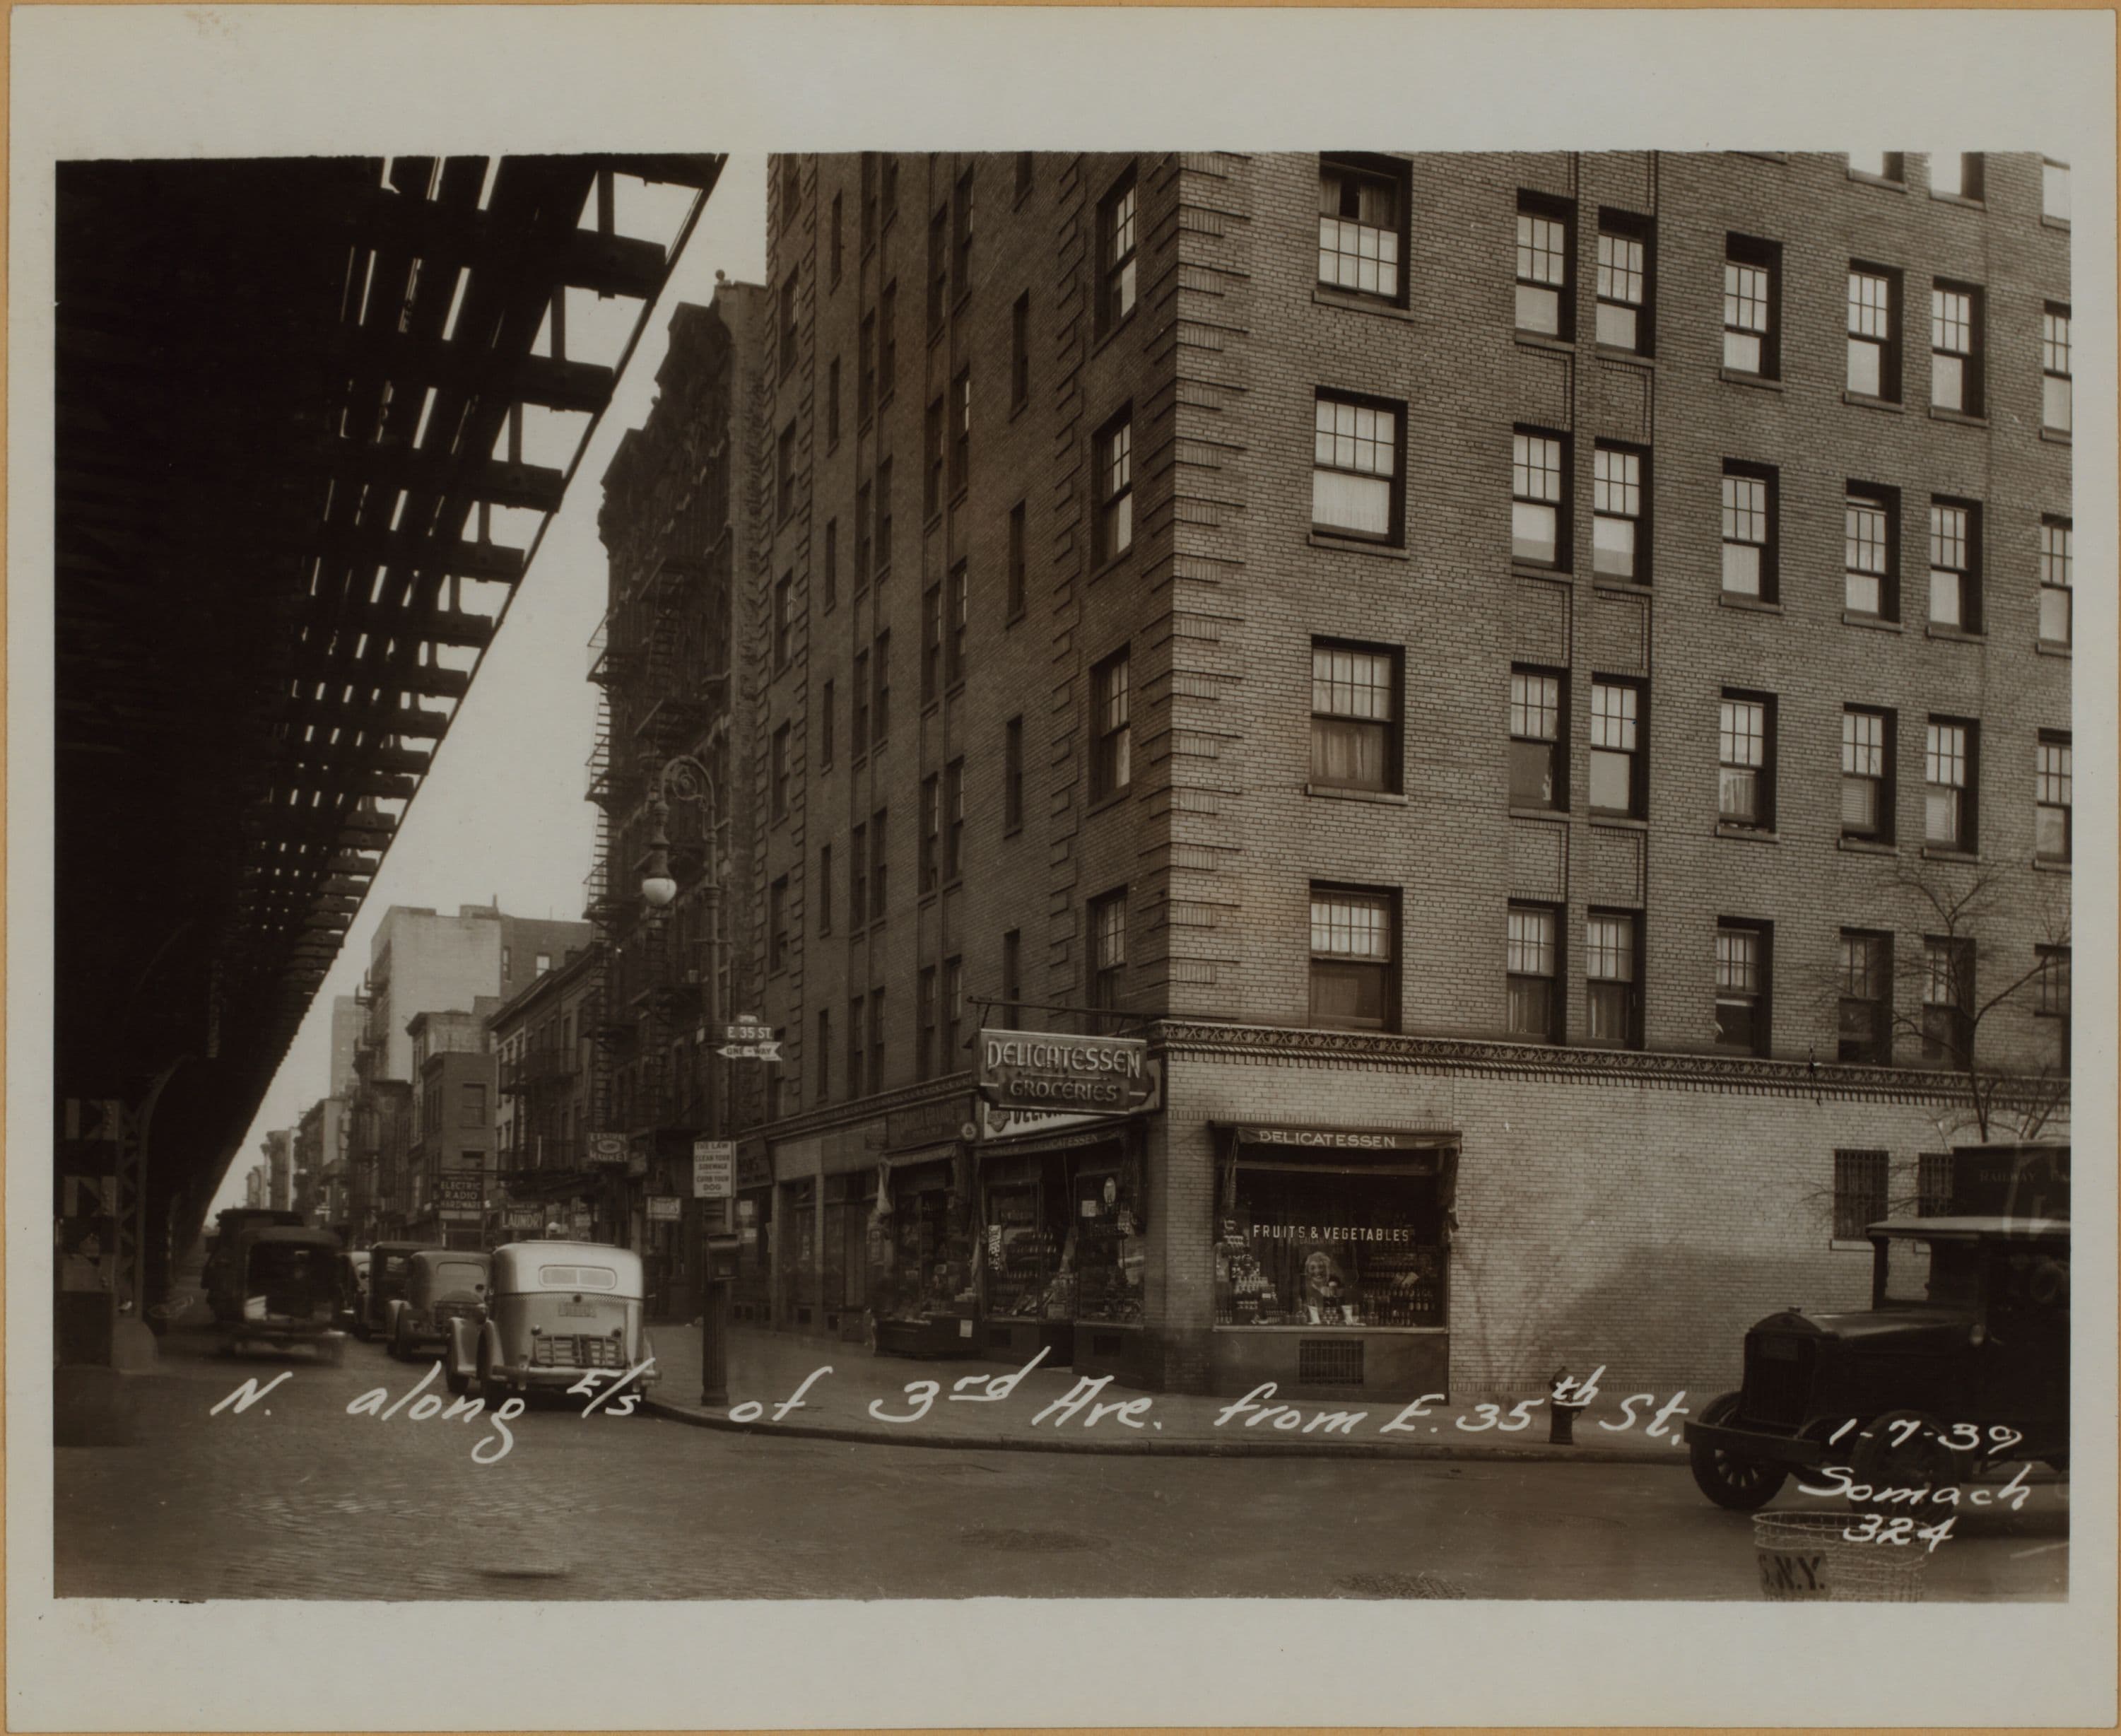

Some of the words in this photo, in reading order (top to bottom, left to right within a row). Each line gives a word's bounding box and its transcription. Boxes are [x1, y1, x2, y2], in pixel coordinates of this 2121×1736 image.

[727, 1026, 736, 1038] E
[739, 1026, 756, 1039] 35
[987, 1040, 1141, 1079] DELICATESSEN
[1010, 1079, 1117, 1102] GROCERIES
[1259, 1130, 1397, 1149] DELICATESSEN
[440, 1181, 481, 1190] ELECTRIC
[445, 1190, 478, 1200] RADIO
[502, 1209, 544, 1228] LAUNDRY
[1253, 1224, 1305, 1238] FRUITS
[1310, 1226, 1319, 1239] &
[1323, 1226, 1409, 1242] VEGETABLES
